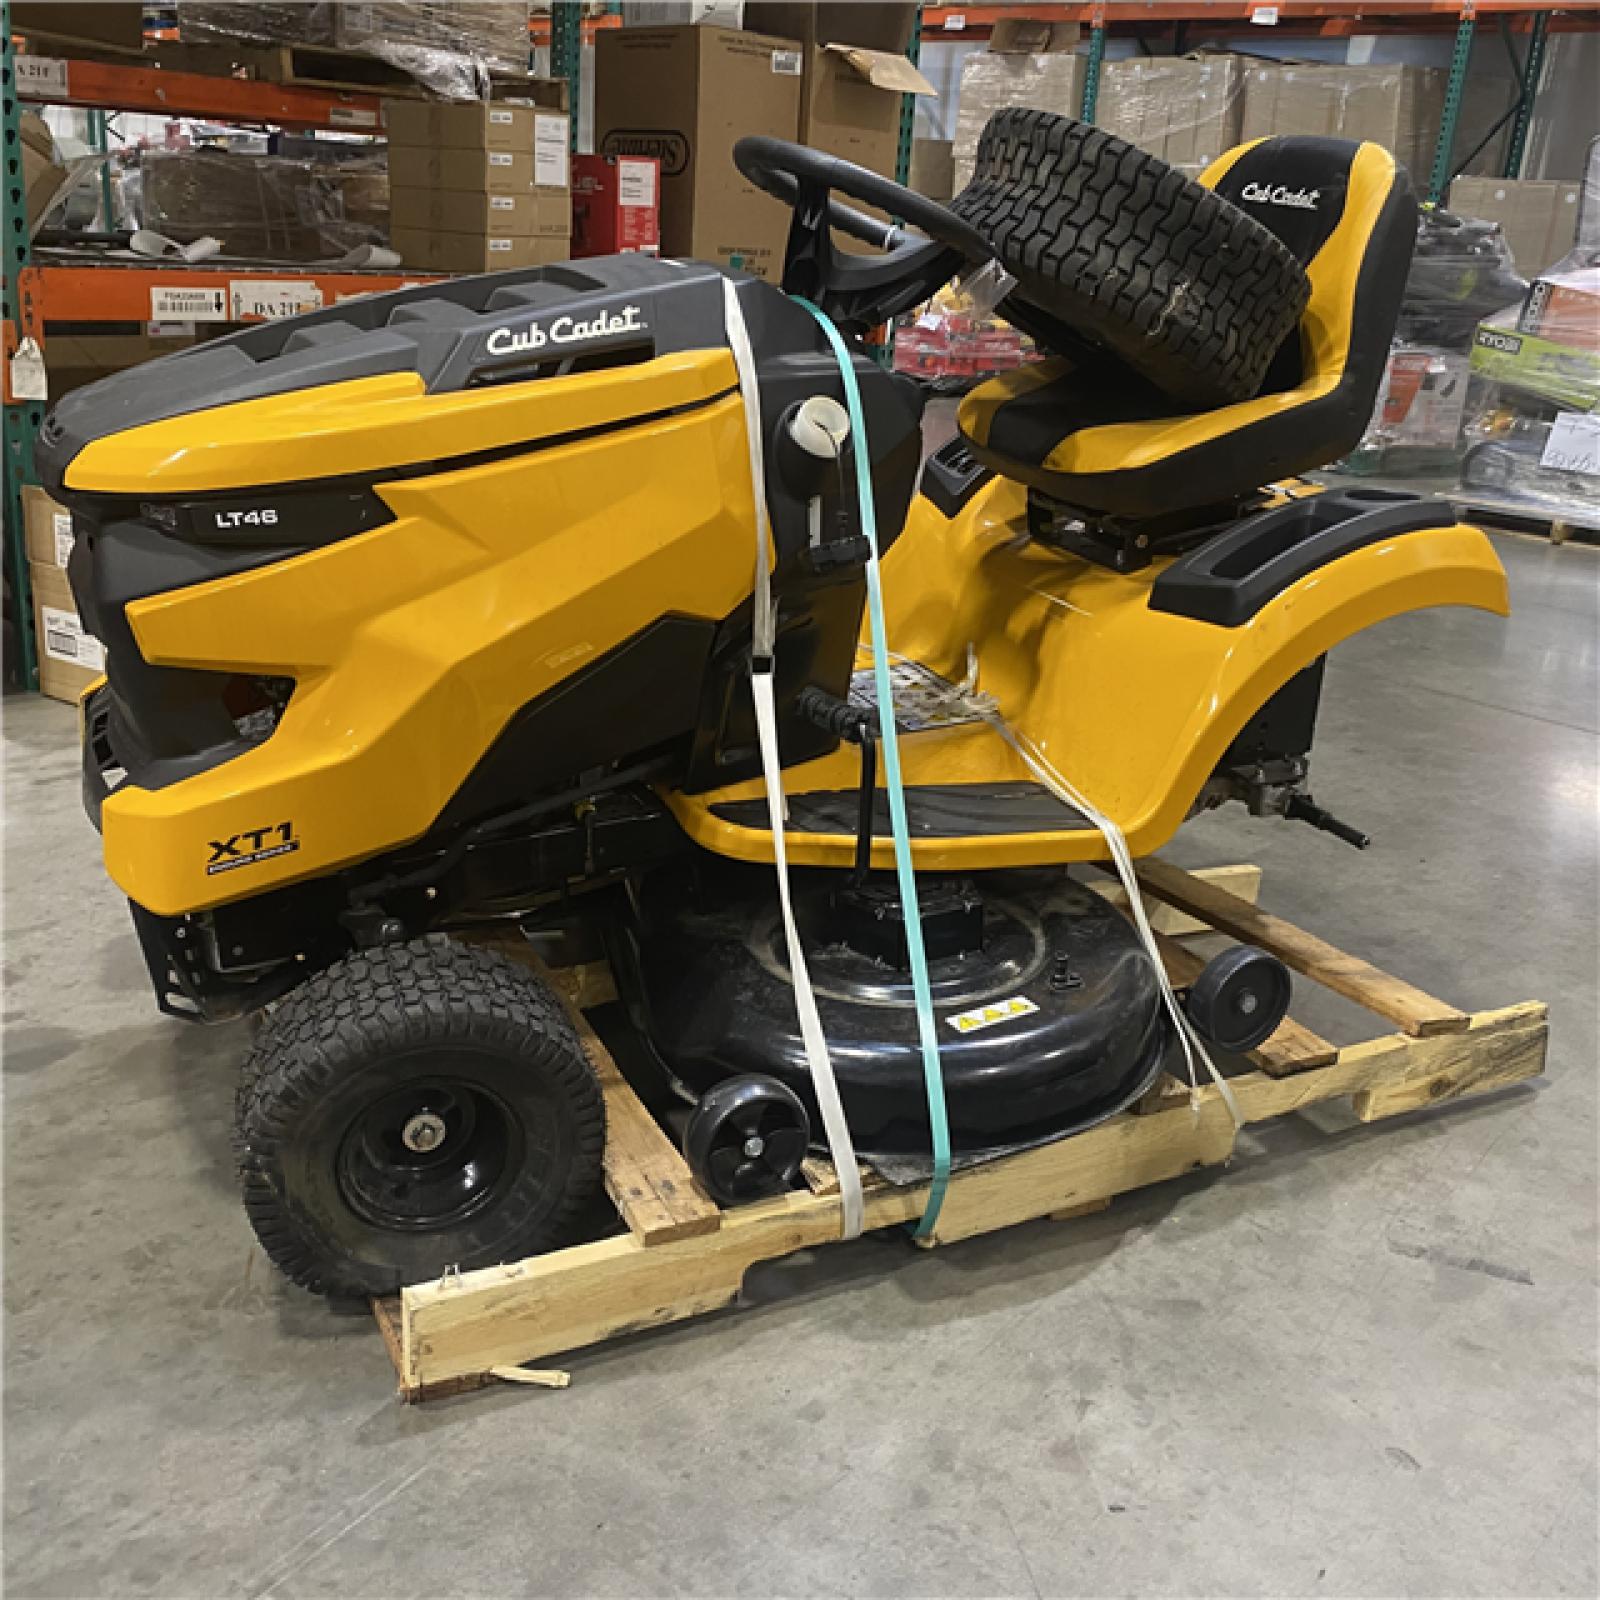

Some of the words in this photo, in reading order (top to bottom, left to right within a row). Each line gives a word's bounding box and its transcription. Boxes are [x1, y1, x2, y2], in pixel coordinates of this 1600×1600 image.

[1241, 182, 1272, 203] Cub
[1271, 184, 1321, 210] Cadet
[487, 322, 547, 355] Cub
[550, 305, 642, 343] Cadet
[214, 509, 279, 528] LT46
[207, 820, 291, 862] XT1
